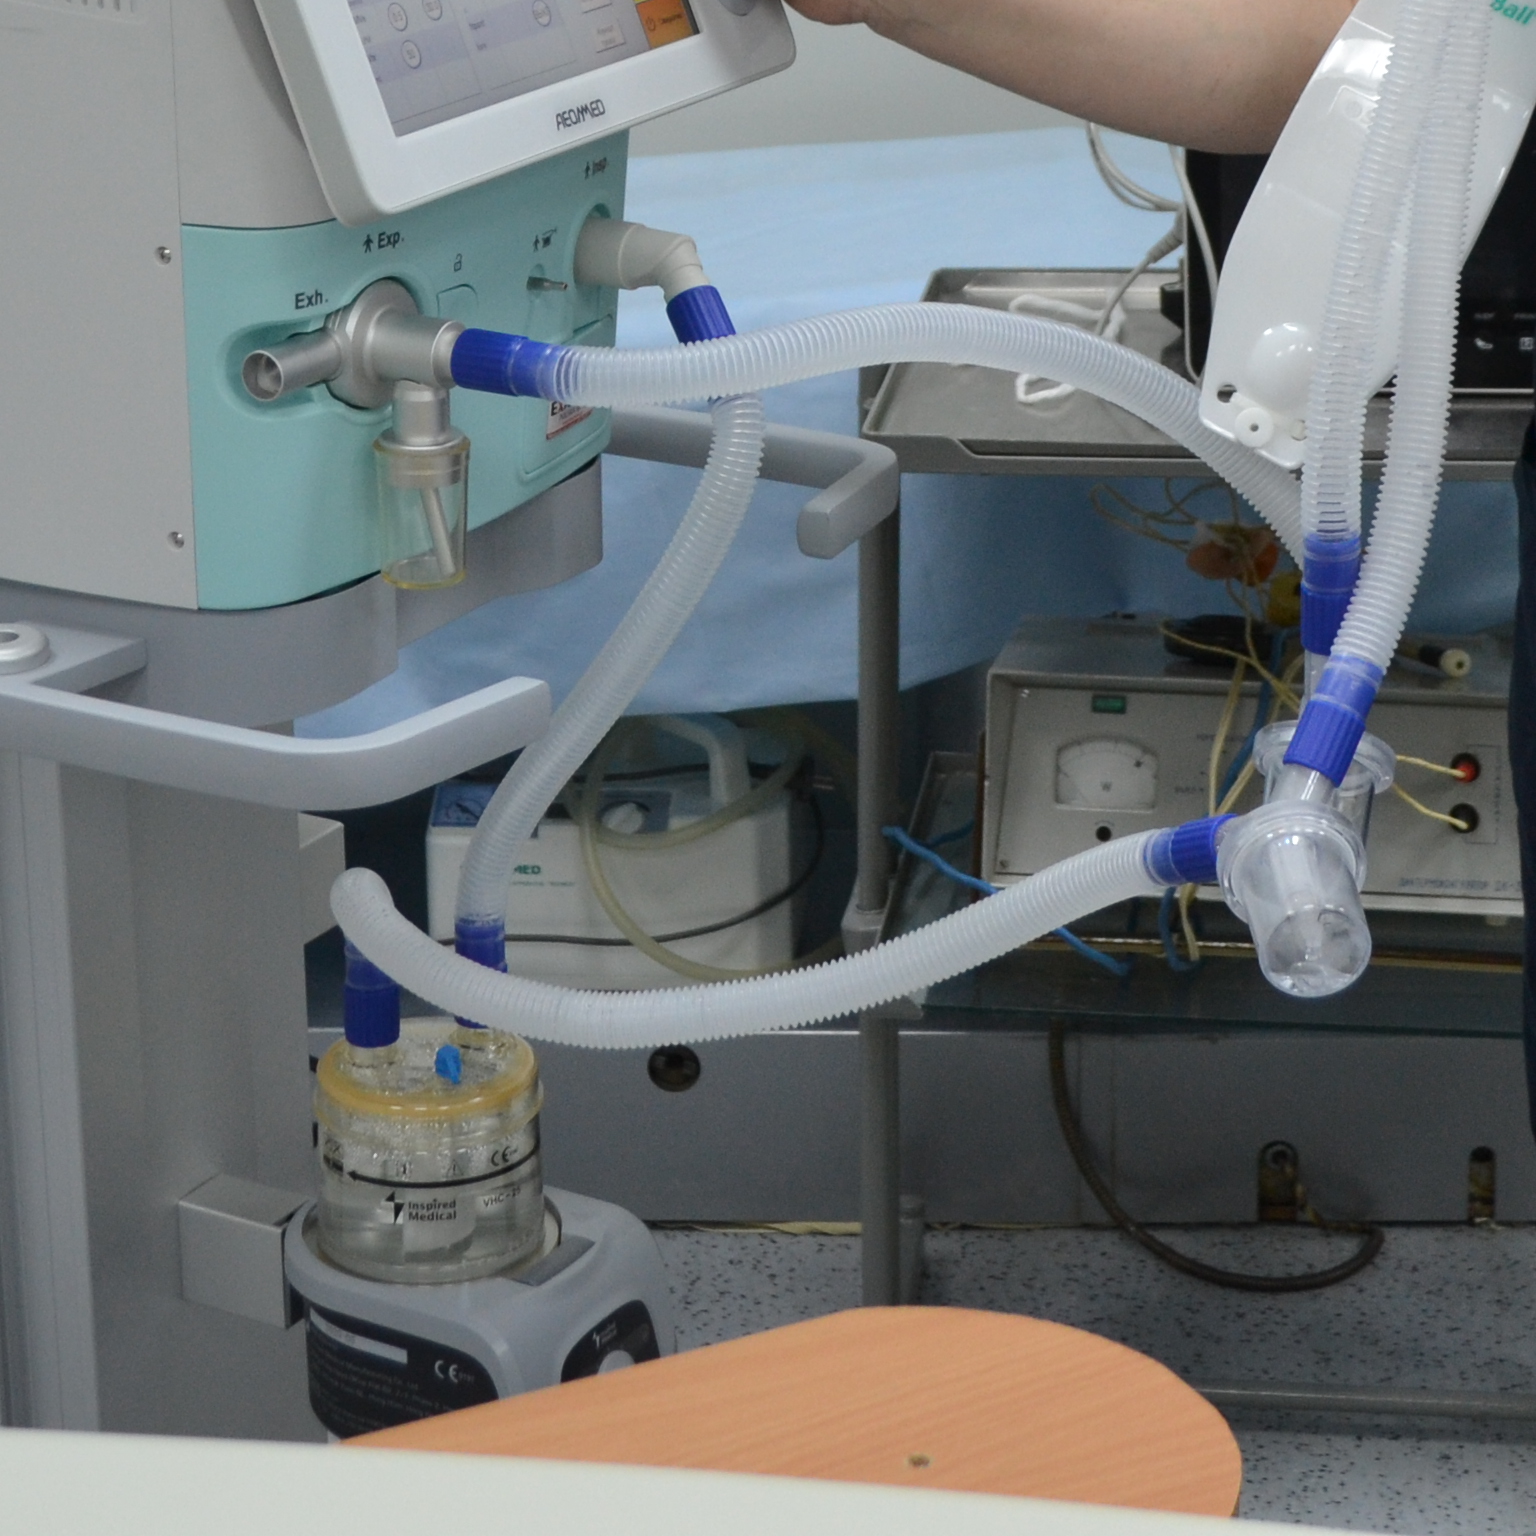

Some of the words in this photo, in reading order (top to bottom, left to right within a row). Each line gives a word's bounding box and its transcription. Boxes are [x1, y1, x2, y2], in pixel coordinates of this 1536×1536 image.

[377, 231, 405, 250] Exp.
[294, 289, 329, 310] Exh.
[408, 1198, 457, 1213] Inspired
[408, 1210, 457, 1222] Medical
